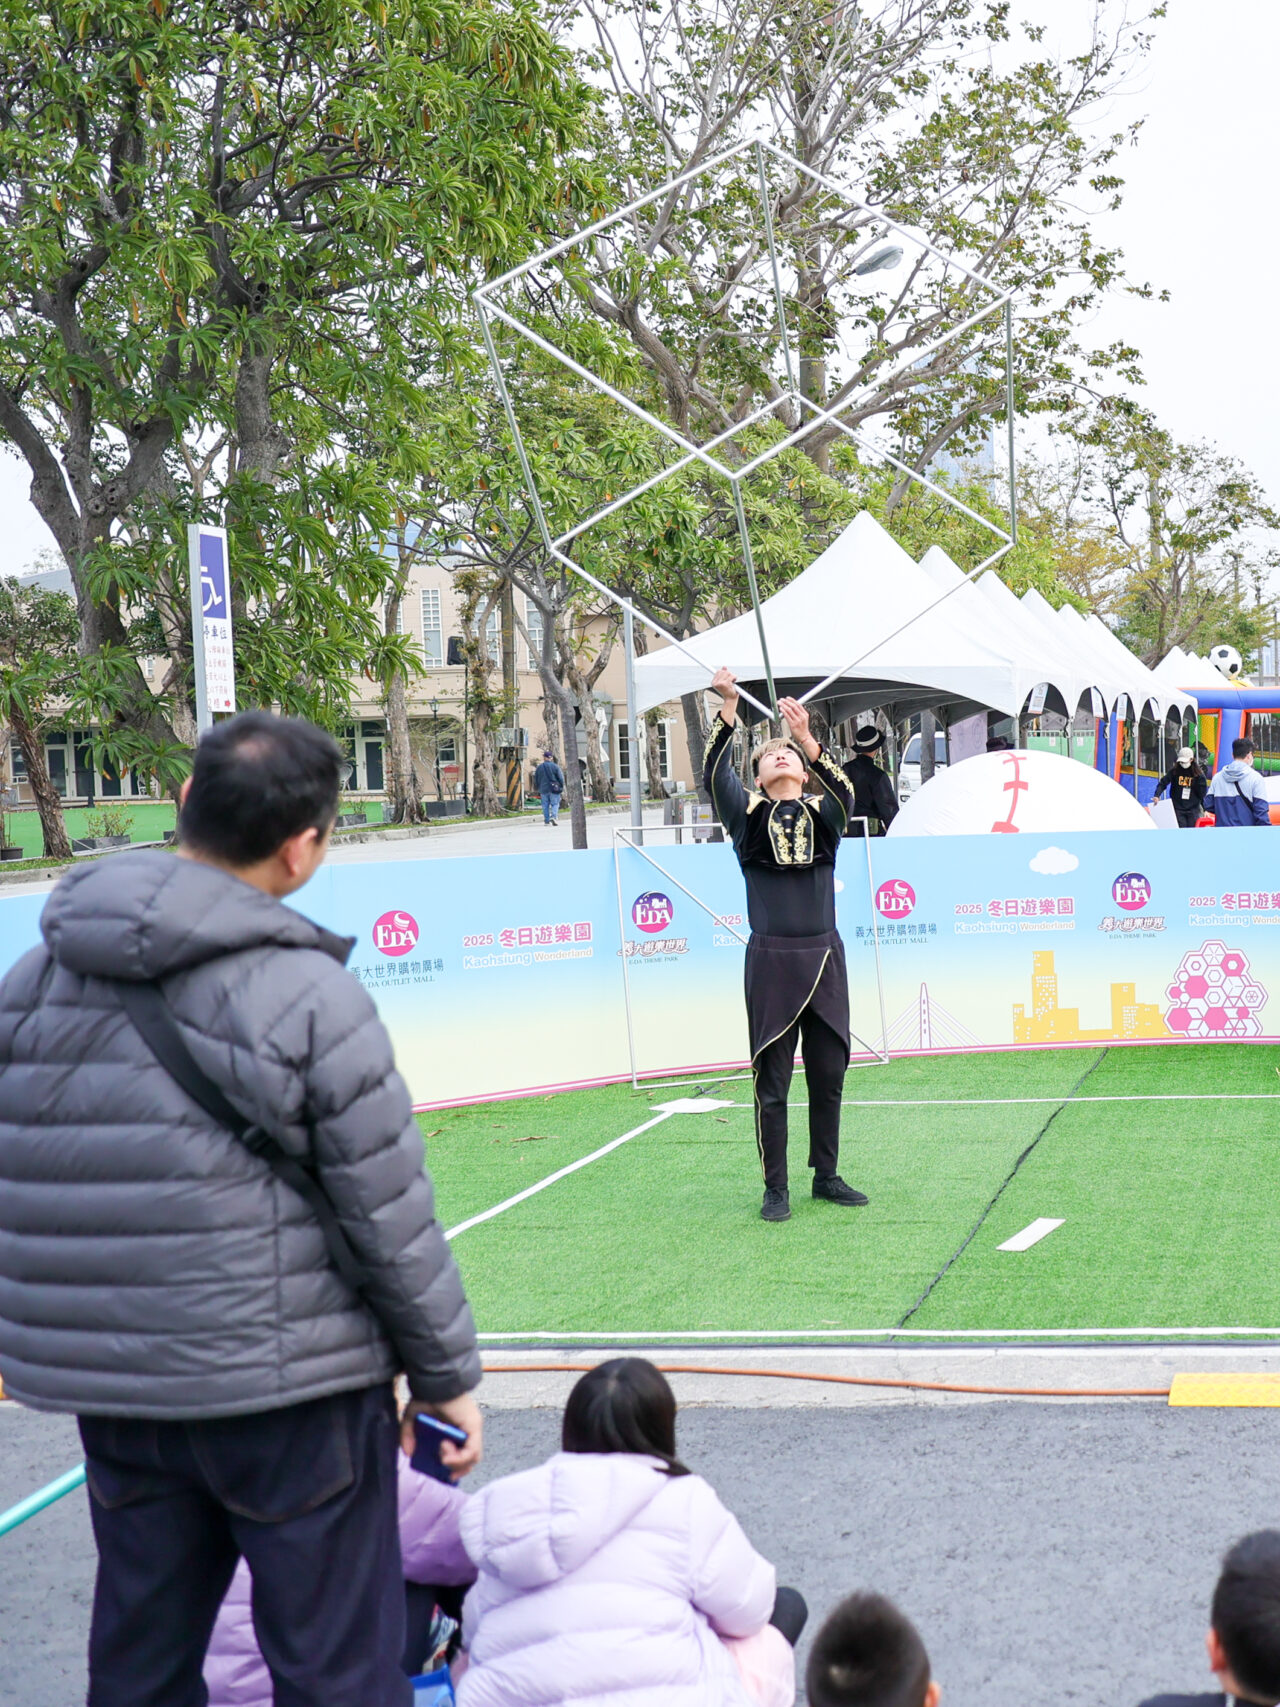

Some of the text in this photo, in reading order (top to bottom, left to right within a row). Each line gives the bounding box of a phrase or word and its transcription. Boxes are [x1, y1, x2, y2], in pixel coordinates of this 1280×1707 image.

[955, 898, 1074, 917] 2025 冬日遊樂園
[1189, 897, 1216, 907] 2025
[1190, 914, 1249, 926] Kaohsiung
[955, 921, 1074, 933] Kaohsiung Wonderland
[463, 922, 592, 948] 2025 冬日遊樂園
[464, 948, 593, 968] Kaohsiung Wonderland
[644, 956, 661, 964] THEME
[381, 977, 411, 987] OUTLET
[413, 975, 436, 984] MALL
